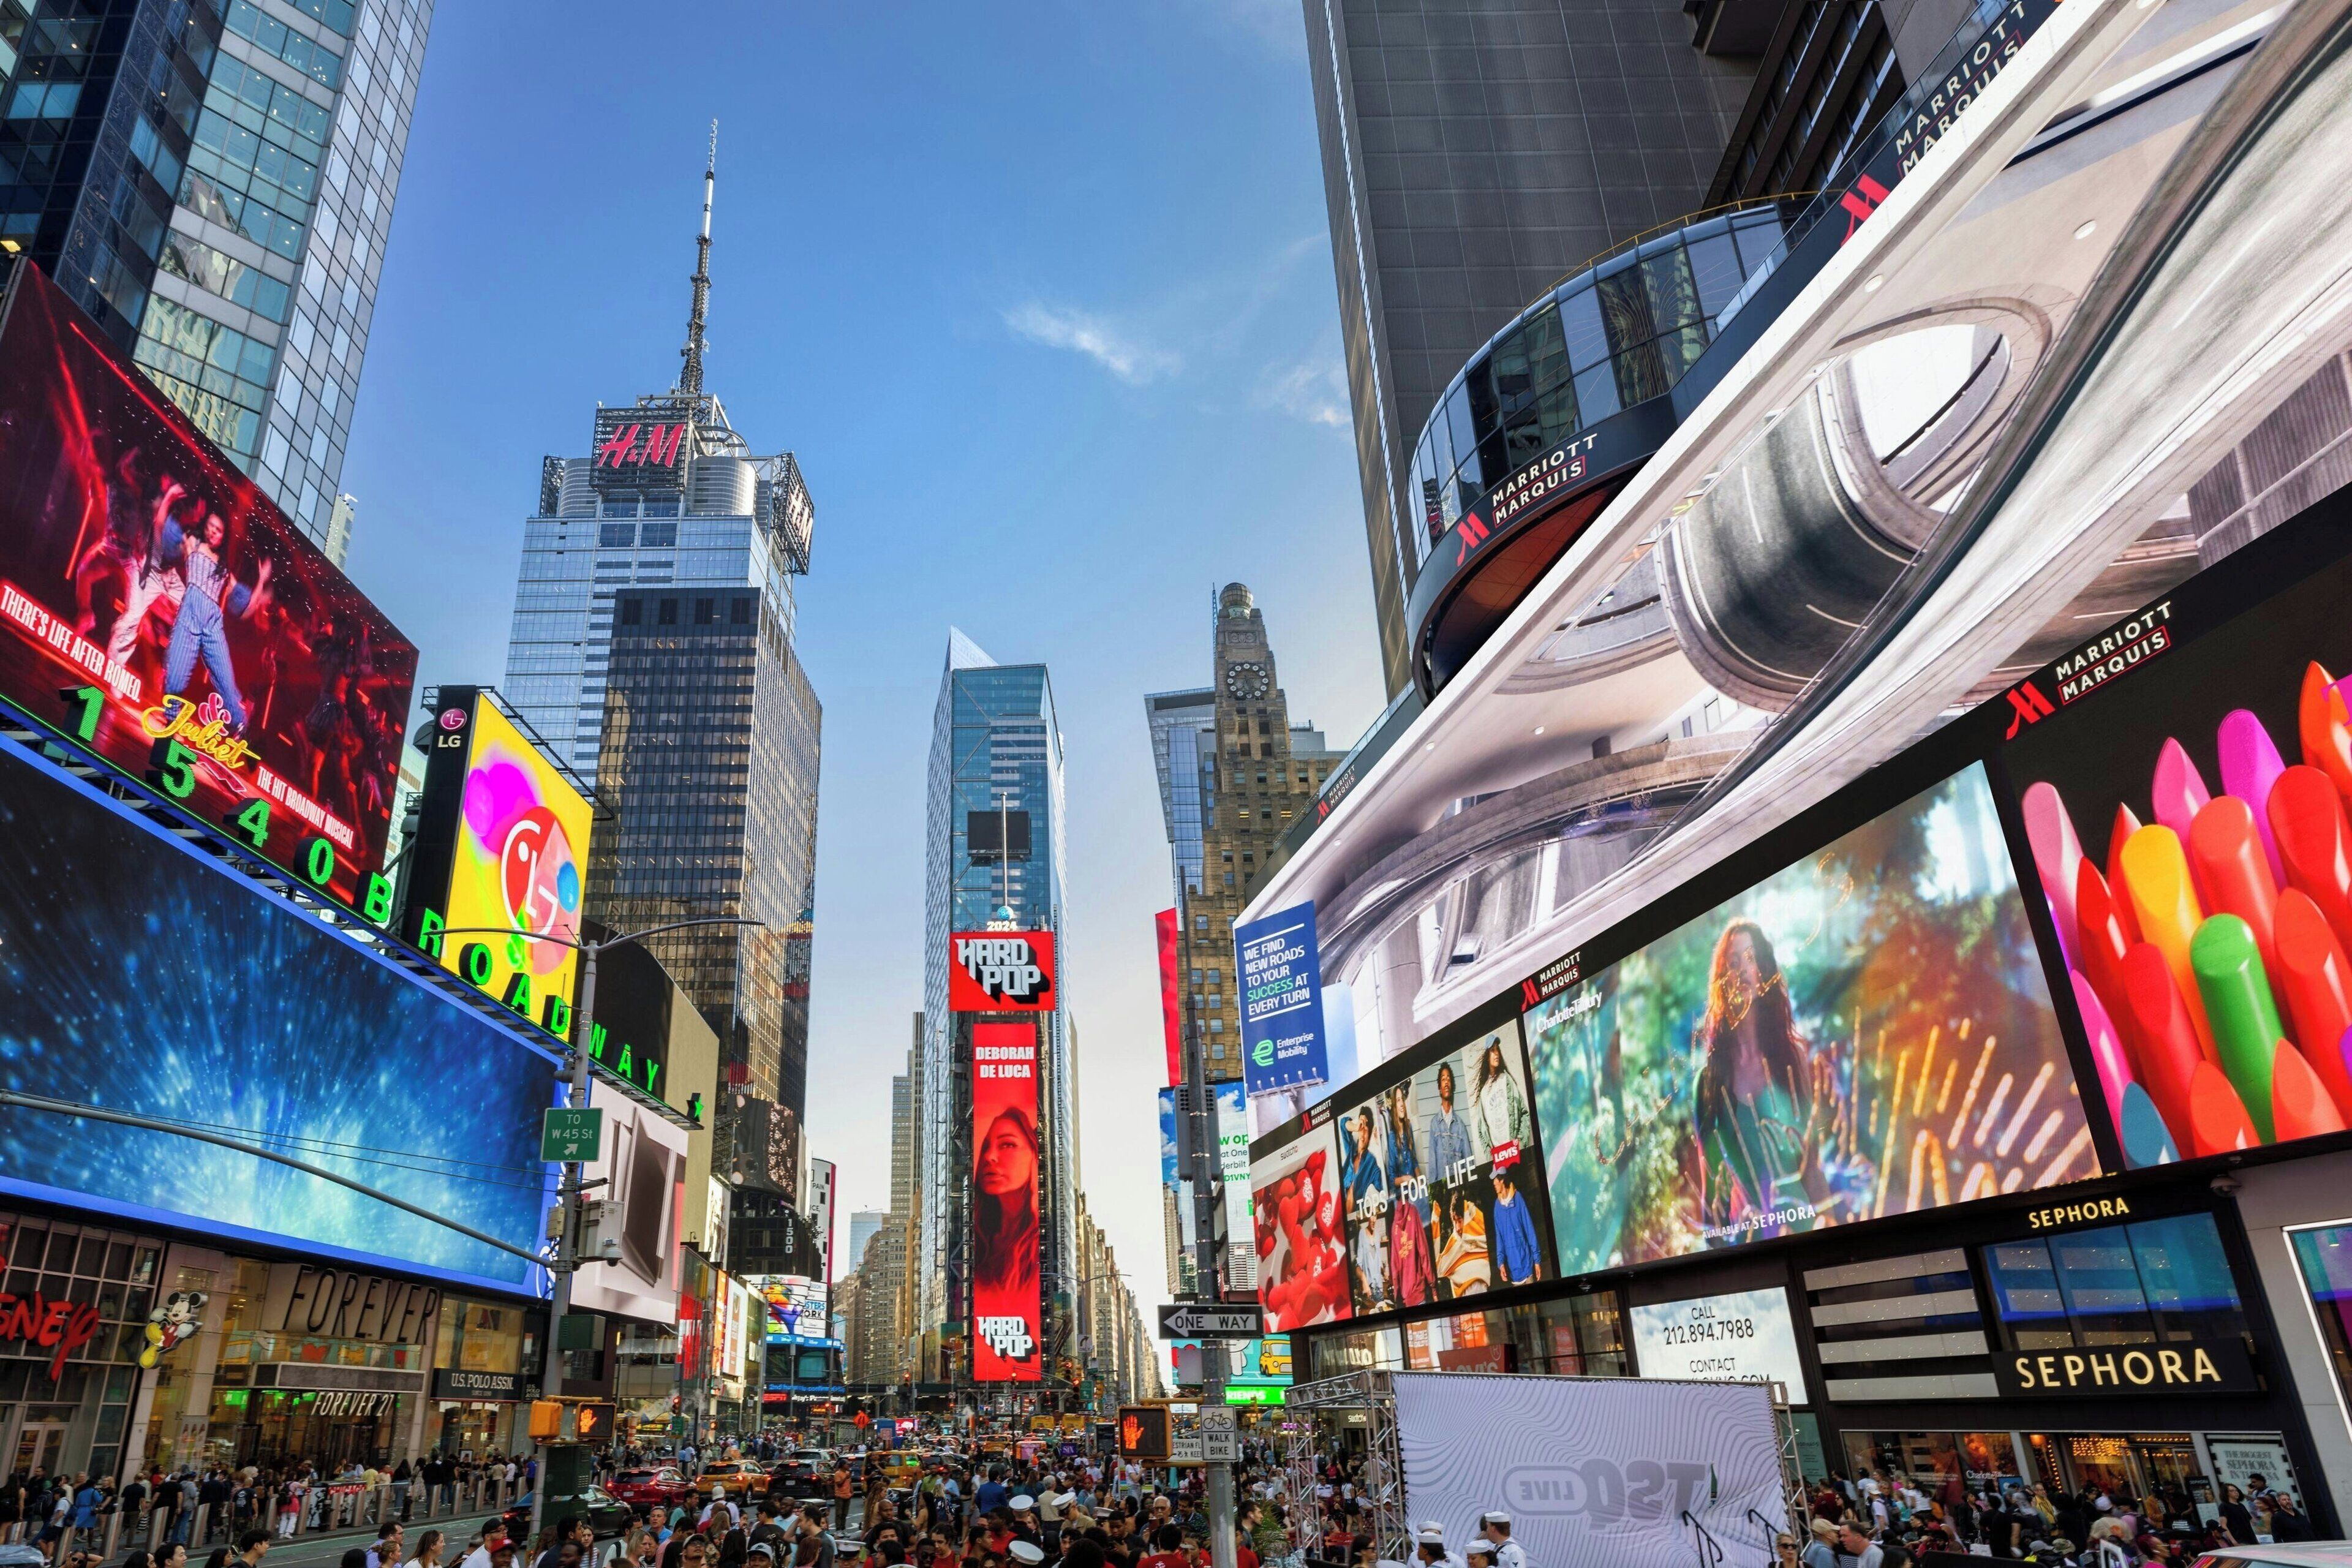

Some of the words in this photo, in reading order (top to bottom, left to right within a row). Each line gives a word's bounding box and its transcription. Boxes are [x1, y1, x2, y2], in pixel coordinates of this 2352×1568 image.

[1896, 0, 2025, 155] MARRIOTT
[1902, 40, 2019, 176] MARQUIS
[597, 424, 685, 469] H&M
[1493, 433, 1597, 507] MARRIOTT
[1495, 461, 1582, 524] MARQUIS
[1, 585, 50, 637] THERE'S
[48, 619, 73, 654] LIFE
[70, 637, 105, 677] AFTER
[104, 659, 141, 703] ROMEO.
[2056, 601, 2171, 680] MARRIOTT
[2062, 632, 2165, 701] MARQUIS
[141, 695, 261, 769] Juliet
[438, 735, 461, 748] LG
[1329, 765, 1355, 797] MARRIOTT
[1330, 775, 1355, 807] MARQUIS
[257, 766, 274, 793] THE
[271, 777, 287, 802] HIT
[285, 786, 326, 829] BROADWAY
[324, 814, 354, 850] MUSICAL
[987, 921, 1018, 931] 2024
[954, 938, 1029, 980] HARD
[1244, 946, 1259, 961] WE
[1262, 938, 1285, 955] FIND
[1246, 958, 1268, 974] NEW
[1270, 945, 1305, 963] ROADS
[979, 965, 1041, 995] POP
[1246, 974, 1261, 987] TO
[1262, 965, 1290, 984] YOUR
[1540, 952, 1580, 982] MARRIOTT
[1542, 968, 1578, 995] MARQUIS
[1248, 978, 1294, 1002] SUCCESS
[1295, 973, 1308, 987] AT
[1248, 995, 1283, 1016] EVERY
[1281, 987, 1310, 1004] TURN
[976, 1046, 1034, 1060] DEBORAH
[1276, 1033, 1314, 1049] Enterprise
[980, 1065, 996, 1078] DE
[998, 1065, 1031, 1078] LUCA
[567, 1114, 581, 1124] TO
[1311, 1099, 1331, 1117] MARRIOTT
[1311, 1110, 1330, 1126] MARQUIS
[552, 1129, 562, 1139] W
[563, 1129, 579, 1139] 45
[581, 1129, 593, 1139] St
[1356, 1190, 1388, 1219] TOPS
[1400, 1175, 1428, 1205] FOR
[1445, 1156, 1478, 1189] LIFE
[1702, 1223, 1738, 1239] AVAILABLE
[1741, 1221, 1751, 1231] AT
[1752, 1204, 1815, 1229] SEPHORA
[2029, 1197, 2130, 1229] SEPHORA
[785, 1219, 794, 1254] 1500
[282, 1264, 439, 1345] FOREVER
[1691, 1306, 1715, 1320] CALL
[976, 1316, 1025, 1346] HARD
[1175, 1316, 1204, 1329] ONE
[1219, 1316, 1250, 1329] WAY
[1664, 1318, 1754, 1345] 212.894.7988
[992, 1335, 1033, 1357] POP
[1690, 1357, 1736, 1373] CONTACT
[2016, 1348, 2222, 1389] SEPHORA
[451, 1373, 466, 1387] U.S.
[467, 1374, 490, 1388] POLO
[491, 1376, 514, 1390] ASSN.
[311, 1392, 377, 1416] FOREVER
[376, 1393, 395, 1416] 21
[1207, 1433, 1230, 1442] WALK
[1210, 1446, 1229, 1455] BIKE
[2226, 1460, 2277, 1470] SEPHORA
